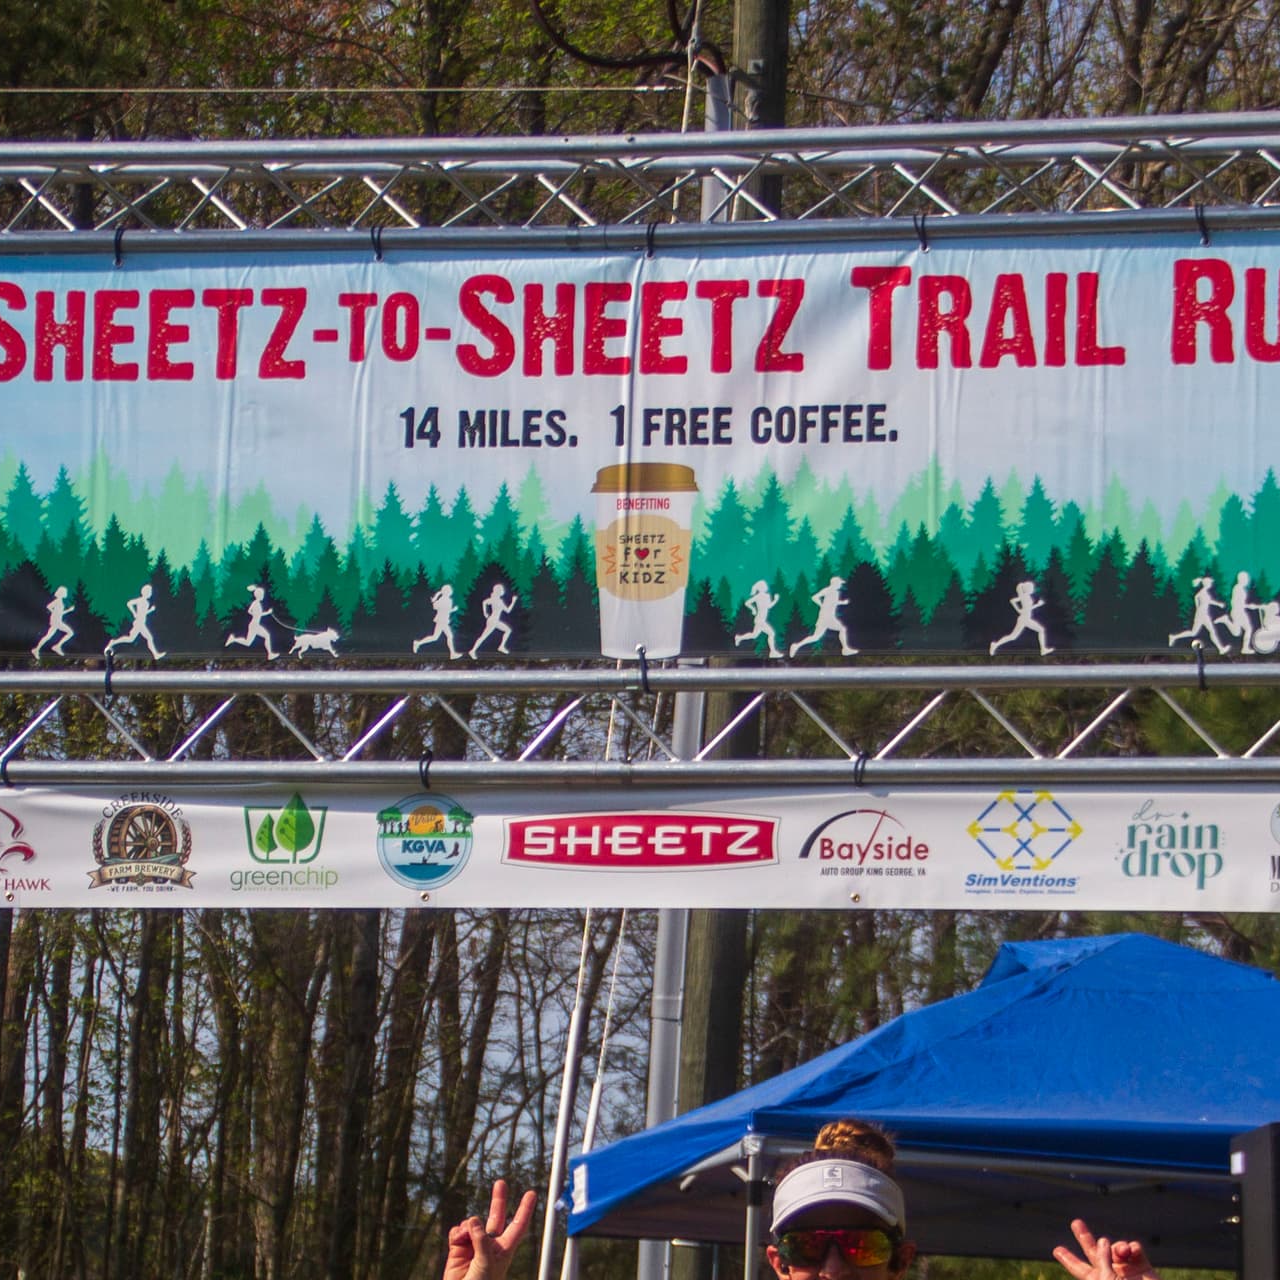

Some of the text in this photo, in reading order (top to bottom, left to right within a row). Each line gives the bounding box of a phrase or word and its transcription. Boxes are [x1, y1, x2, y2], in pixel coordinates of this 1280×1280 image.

[850, 265, 1126, 372] TRAIL
[399, 403, 899, 449] 14 MILES. 1 FREE COFFEE.
[616, 498, 670, 511] BENEFITING
[619, 534, 666, 545] SHEETZ
[619, 571, 666, 585] KIDZ
[102, 791, 184, 820] CREEKSIDE
[1127, 812, 1219, 850] rain
[401, 839, 447, 854] KGVA
[523, 825, 761, 857] SHEETZ
[819, 836, 929, 866] Bayside
[108, 865, 176, 877] FARM BREWERY
[820, 867, 839, 876] AUTO
[840, 867, 864, 876] GROUP
[865, 867, 883, 876] KING
[1121, 839, 1224, 891] drop
[4, 877, 52, 892] HAWK
[230, 867, 339, 891] greenchip
[965, 874, 1077, 888] SimVentions
